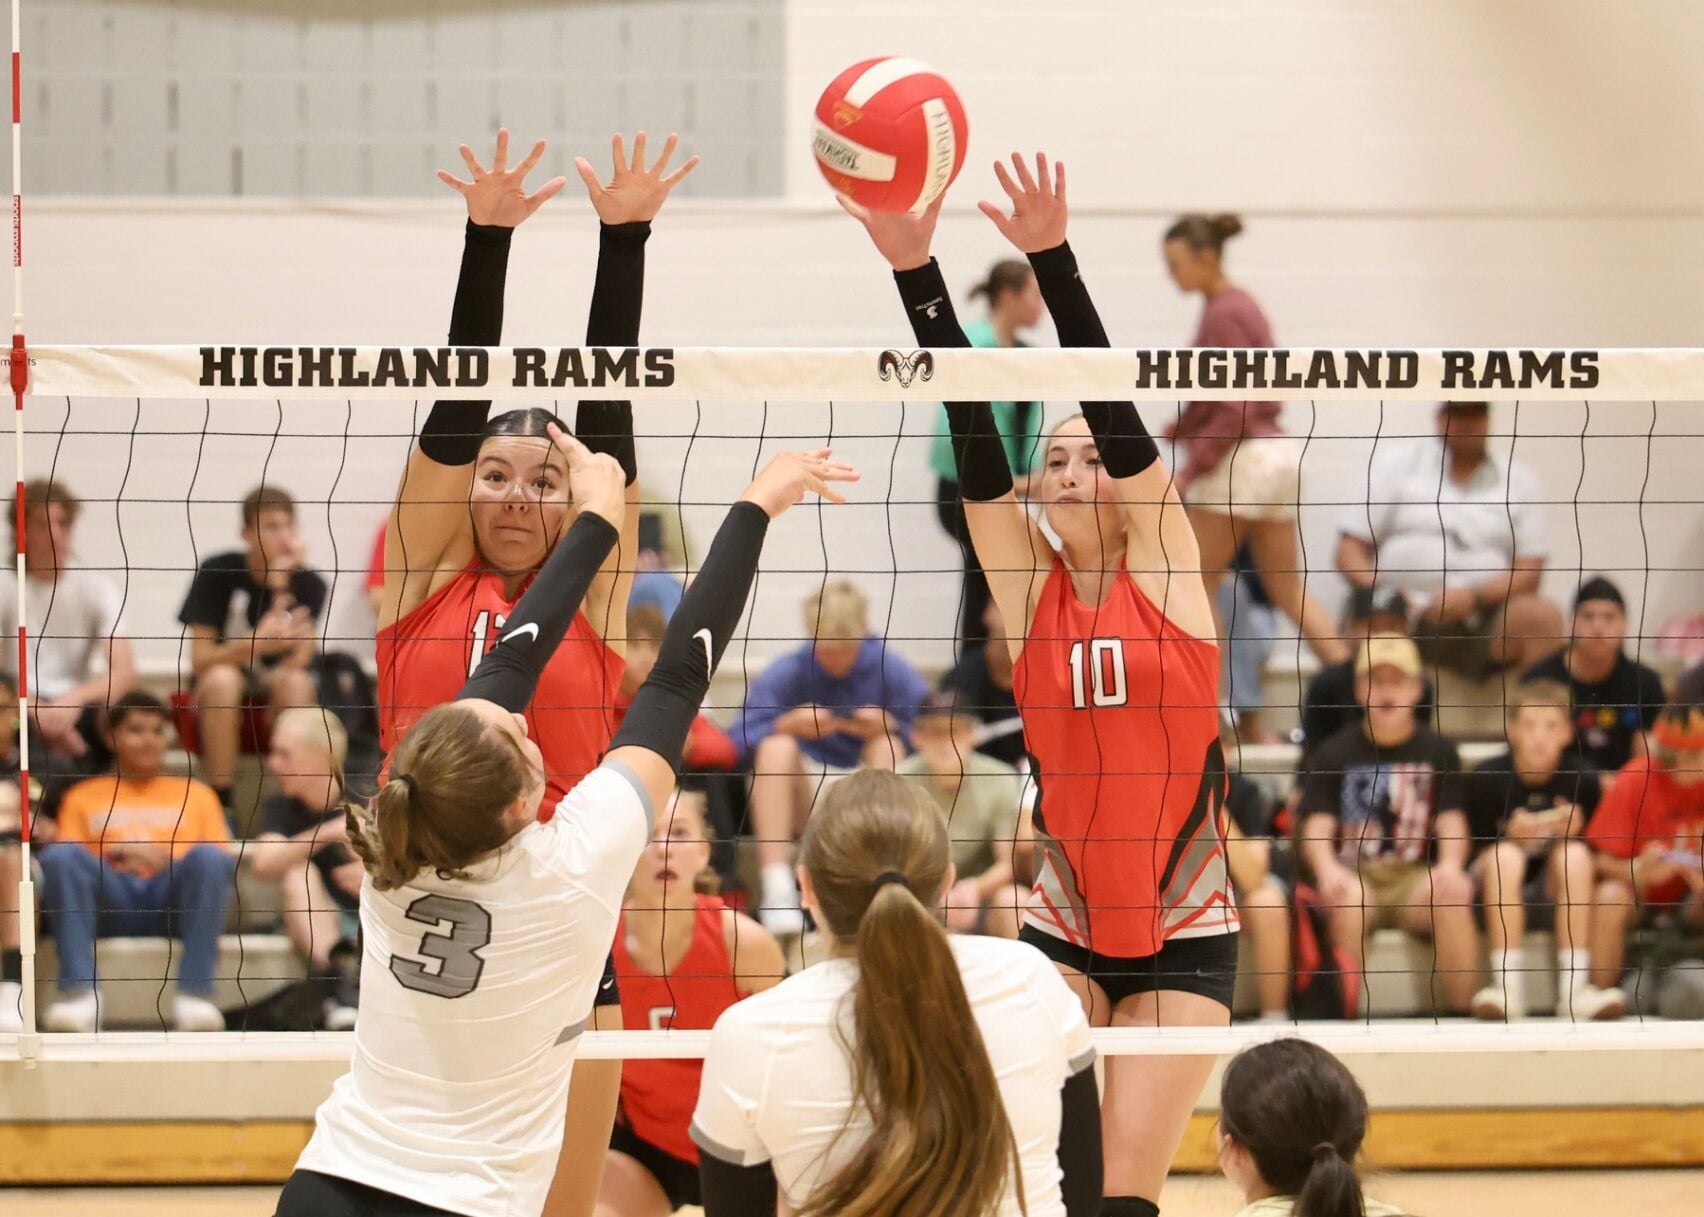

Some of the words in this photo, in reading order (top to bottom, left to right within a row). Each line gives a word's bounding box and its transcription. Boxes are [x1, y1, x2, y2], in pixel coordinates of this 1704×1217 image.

[200, 347, 489, 387] HIGHLAND
[512, 348, 675, 387] RAMS
[1135, 350, 1418, 389] HIGHLAND
[1441, 350, 1600, 389] RAMS
[1068, 636, 1128, 710] 10
[389, 893, 492, 999] 3
